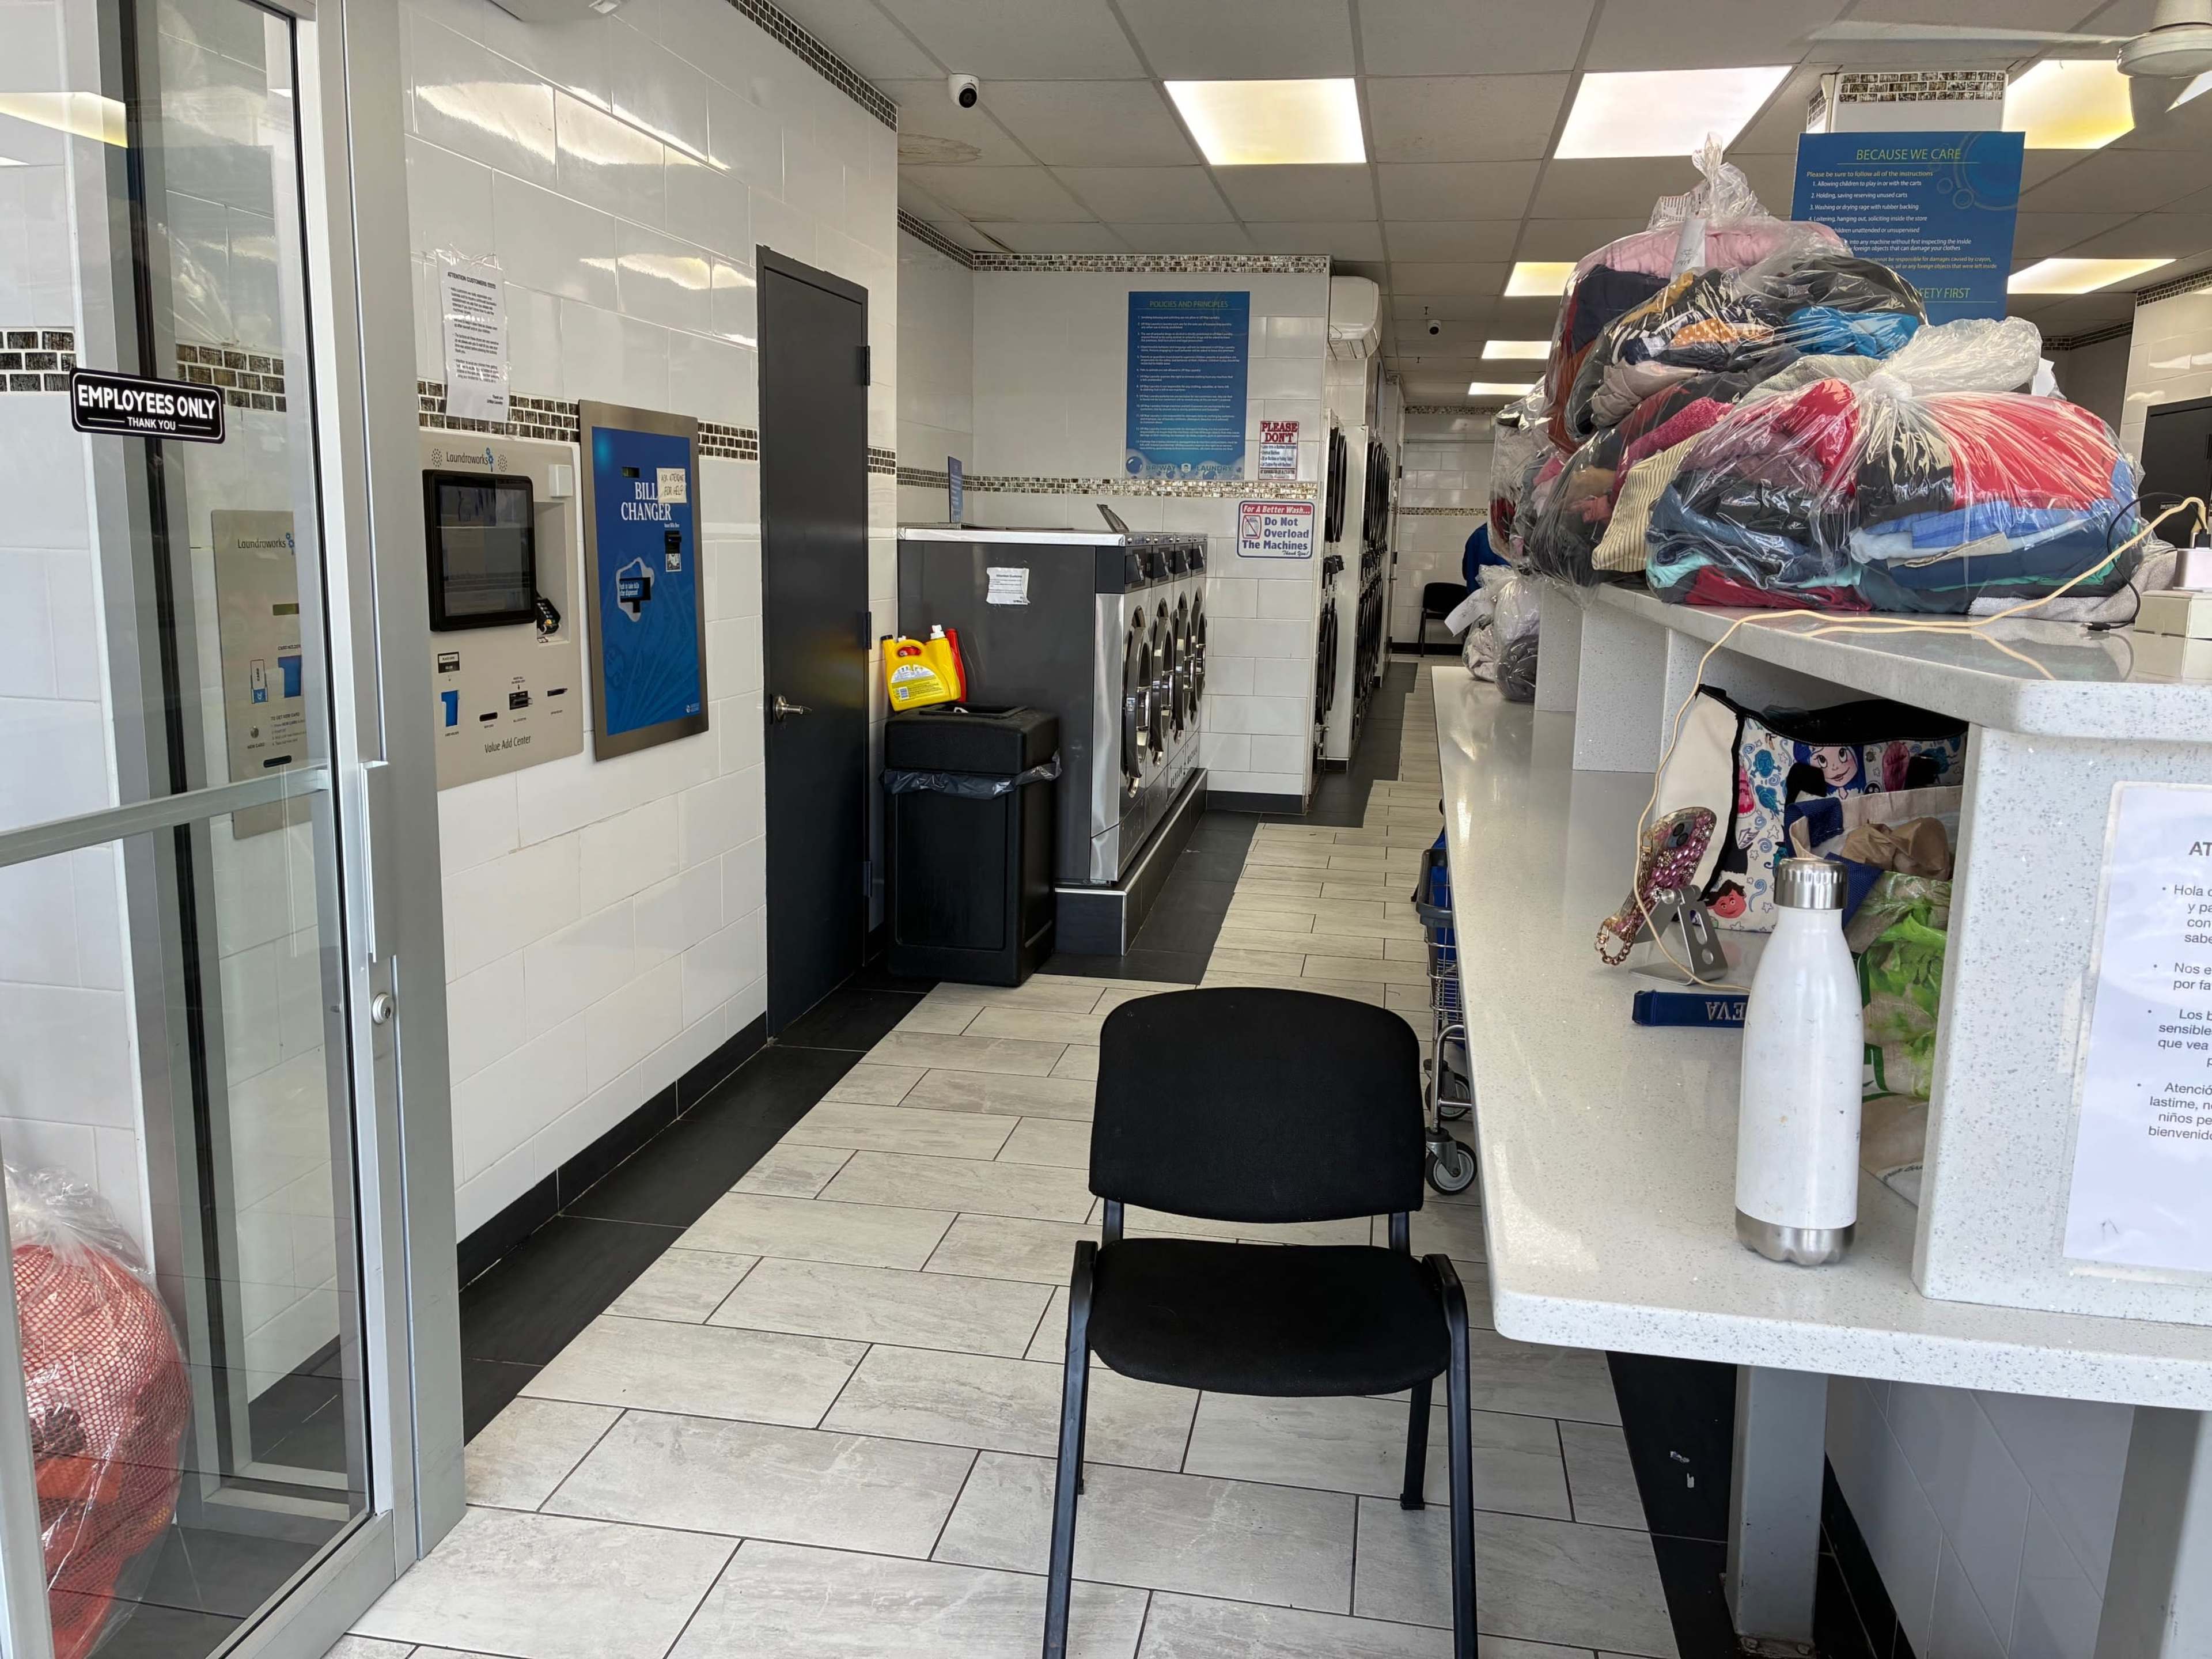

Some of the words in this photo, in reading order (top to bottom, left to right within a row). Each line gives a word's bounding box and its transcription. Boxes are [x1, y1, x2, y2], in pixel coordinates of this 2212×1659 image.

[1857, 149, 1908, 160] BECAUSE
[1910, 149, 1928, 160] WE
[1931, 149, 1961, 160] CARE
[1918, 287, 1943, 298] FETY
[1944, 287, 1971, 298] FIRST
[78, 384, 175, 415] EMPLOYEES
[177, 396, 216, 419] ONLY
[127, 416, 157, 429] THANK
[158, 419, 176, 430] YOU
[1262, 422, 1298, 433] PLEASE
[1264, 433, 1294, 443] DON'T
[446, 452, 488, 465] Laundroworks
[635, 482, 658, 500] BILL
[621, 502, 672, 521] CHANGER
[1286, 506, 1310, 514] Wash...
[1264, 517, 1277, 526] Do
[1281, 517, 1298, 527] Not
[1264, 528, 1309, 538] Overload
[237, 537, 286, 548] Laundroworks
[1242, 540, 1260, 549] The
[1263, 540, 1308, 550] Machines
[484, 741, 501, 753] Value
[501, 737, 513, 749] Add
[513, 736, 531, 747] Center
[2174, 884, 2203, 896] Hola
[2187, 903, 2196, 914] y
[2187, 919, 2212, 928] con
[2174, 962, 2200, 974] Nos
[2173, 980, 2196, 990] por
[2199, 980, 2212, 991] fa
[2179, 1009, 2203, 1020] Los
[2158, 1039, 2183, 1050] que
[2186, 1041, 2209, 1050] vea
[2149, 1096, 2198, 1111] lastime,
[2158, 1112, 2193, 1124] niños
